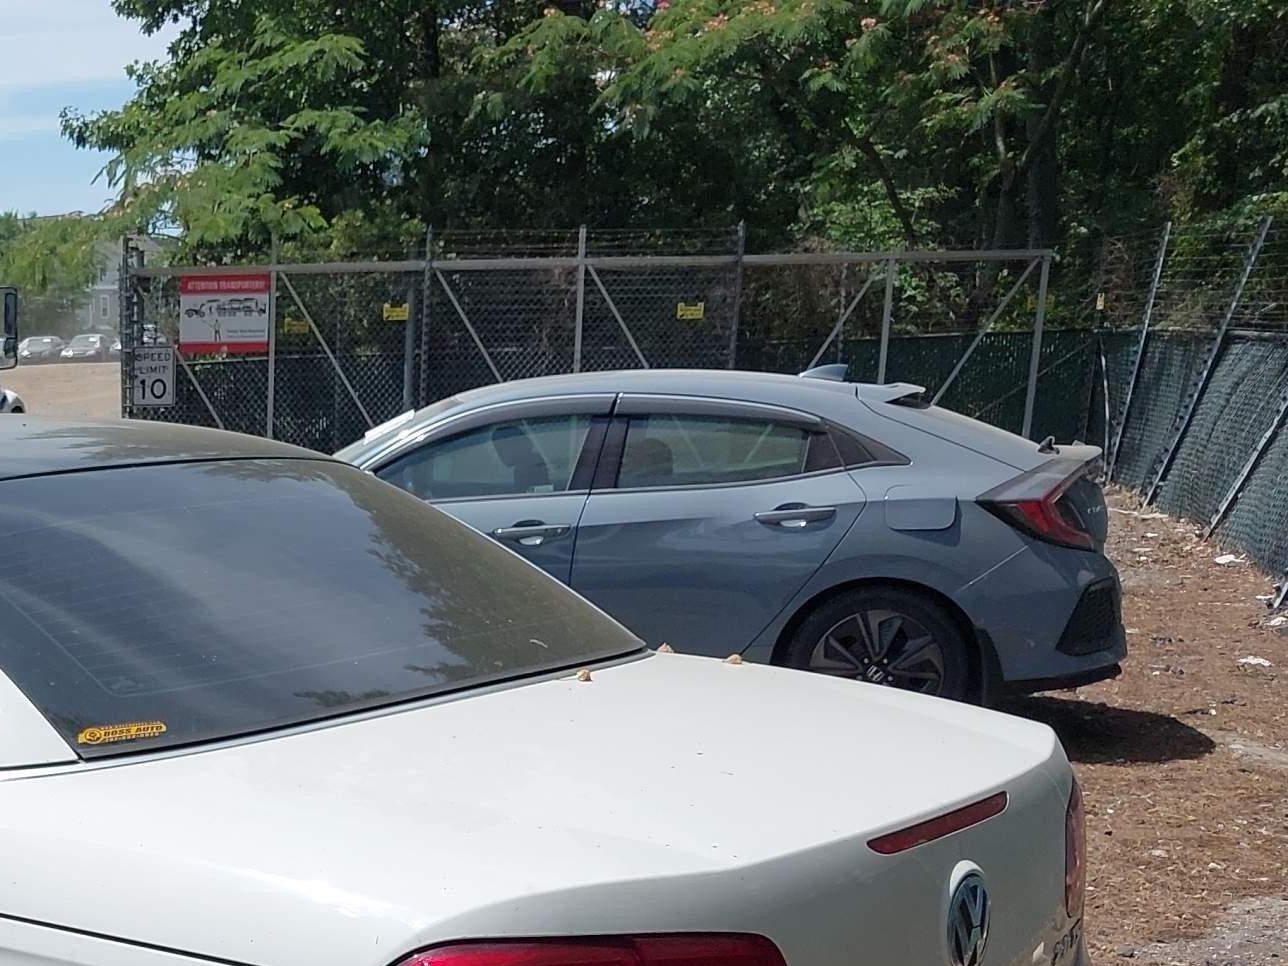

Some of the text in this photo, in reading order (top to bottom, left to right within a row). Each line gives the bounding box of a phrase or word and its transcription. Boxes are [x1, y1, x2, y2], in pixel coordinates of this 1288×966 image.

[135, 352, 171, 362] SPEED
[139, 365, 169, 374] LIMIT
[140, 378, 167, 400] 10
